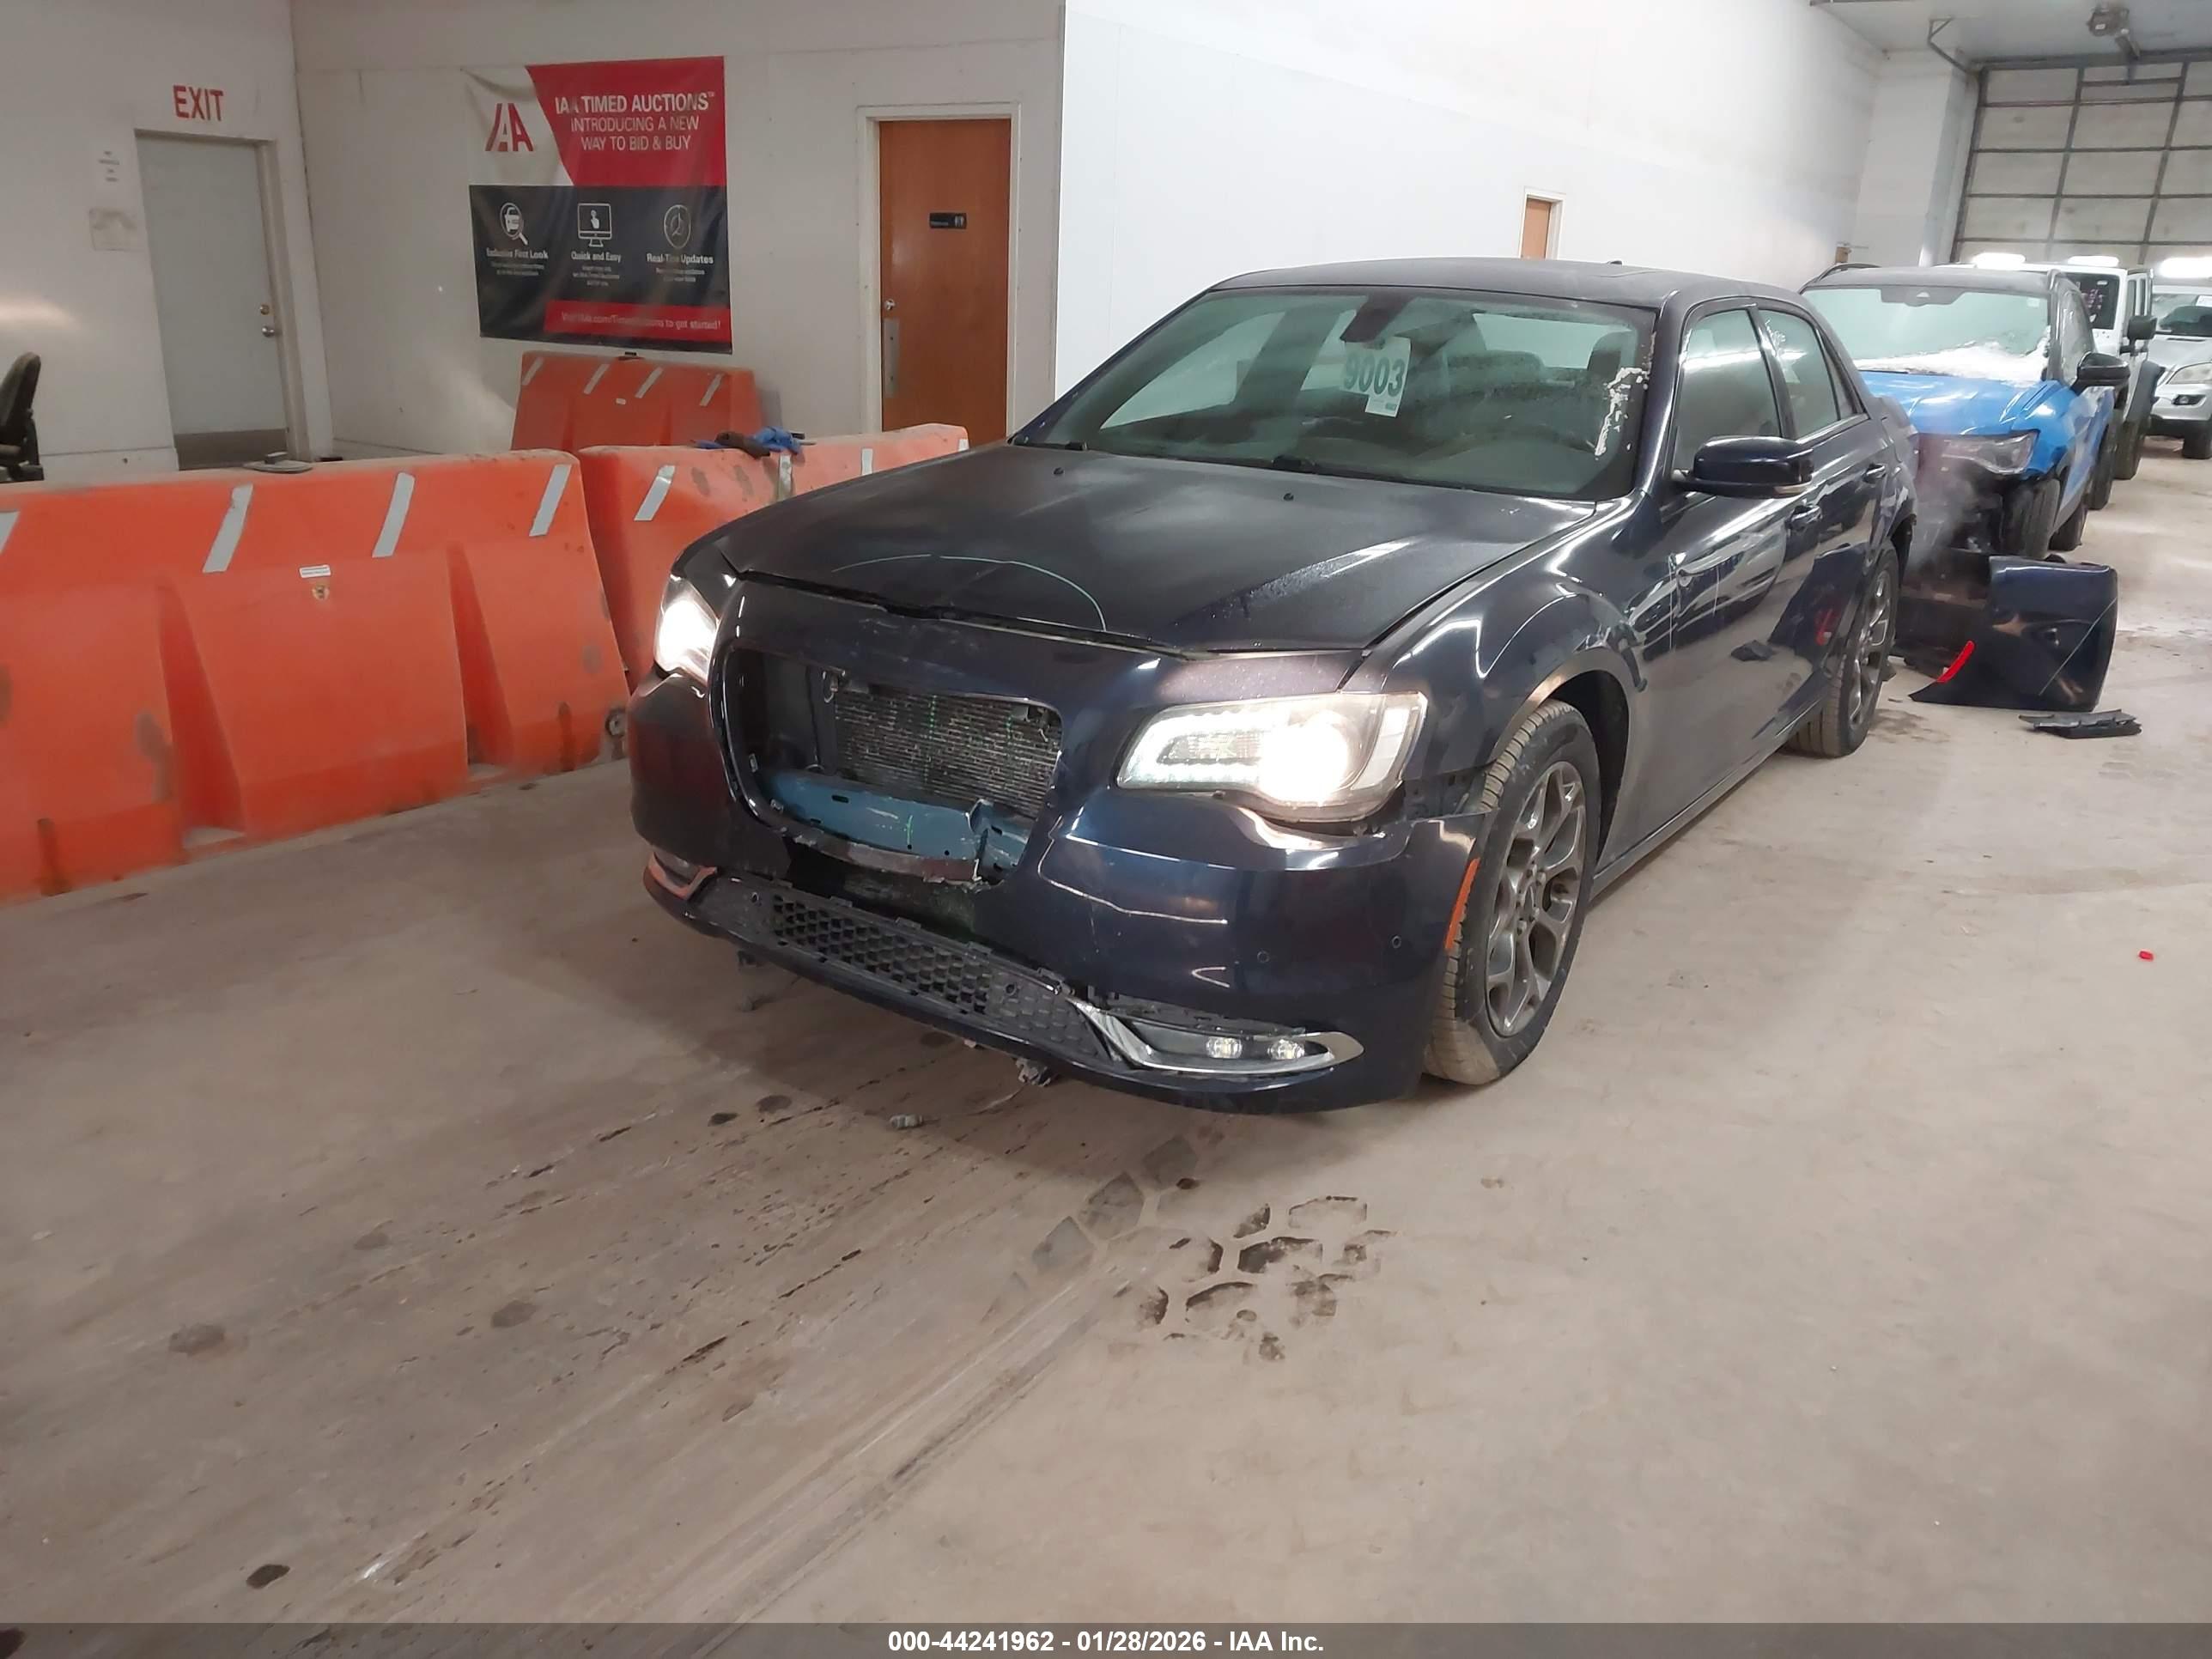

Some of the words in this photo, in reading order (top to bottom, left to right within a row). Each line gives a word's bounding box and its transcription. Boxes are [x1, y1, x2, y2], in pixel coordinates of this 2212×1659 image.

[173, 84, 223, 121] EXIT
[581, 94, 627, 113] TIMED
[571, 117, 653, 132] INTRODUCING
[658, 117, 666, 131] A
[671, 116, 700, 131] NEW
[580, 137, 606, 150] WAY
[610, 137, 626, 150] TO
[629, 137, 649, 150] BID
[652, 136, 661, 150] &
[665, 136, 691, 150] BUY
[1344, 352, 1406, 397] 9003
